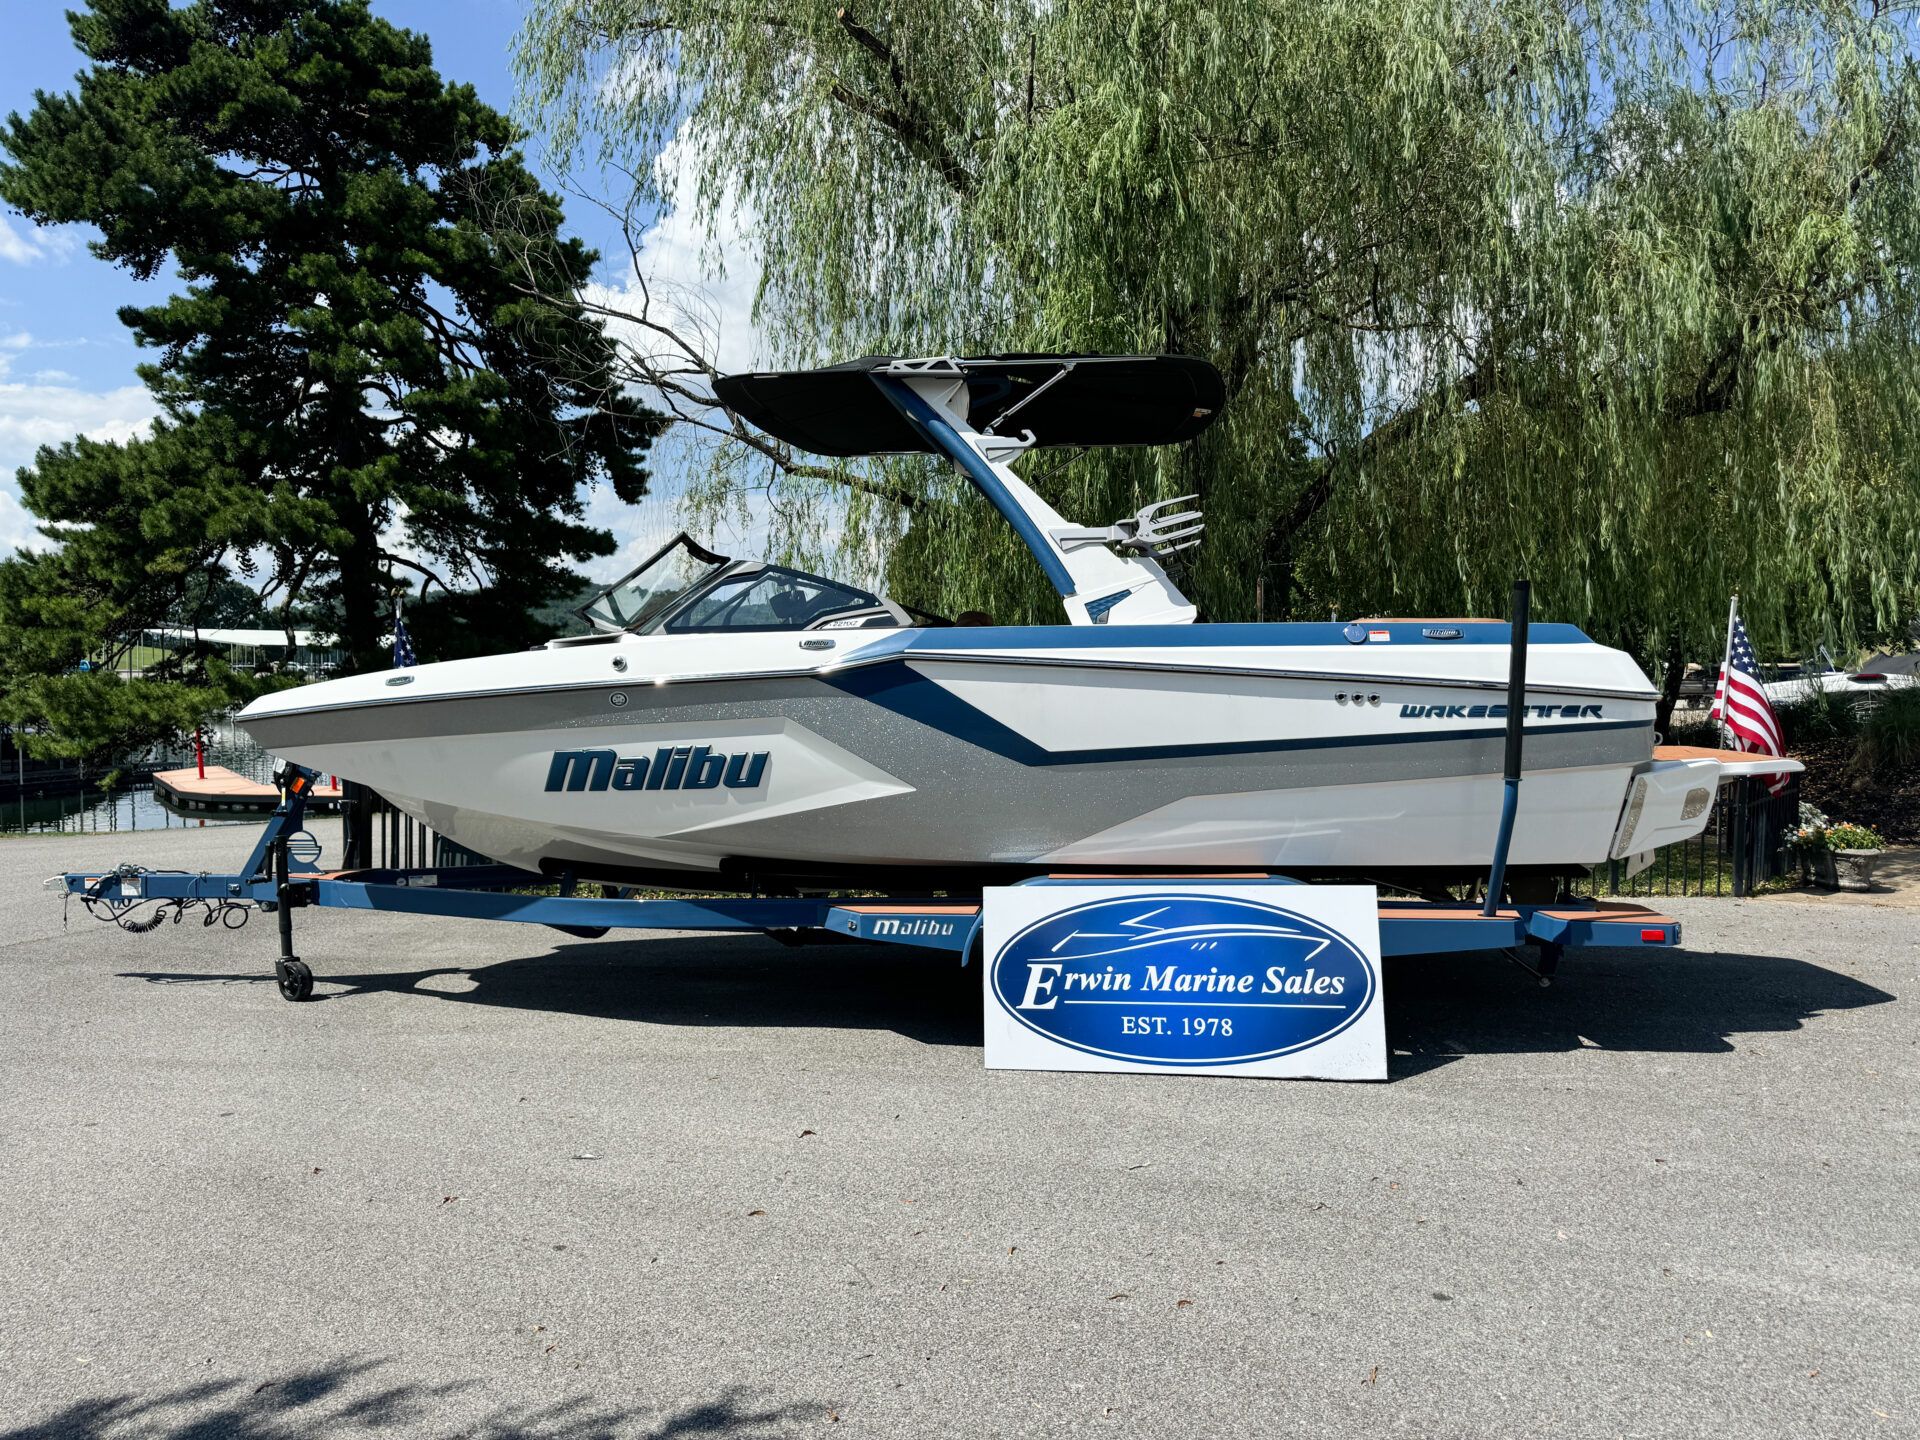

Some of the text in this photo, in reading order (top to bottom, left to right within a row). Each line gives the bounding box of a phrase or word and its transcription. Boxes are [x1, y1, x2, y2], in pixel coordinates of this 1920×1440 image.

[544, 745, 770, 792] Malibu
[873, 919, 954, 936] Malibu
[1016, 963, 1346, 1010] Erwin Marine Sales
[1121, 1016, 1234, 1038] EST. 1978
